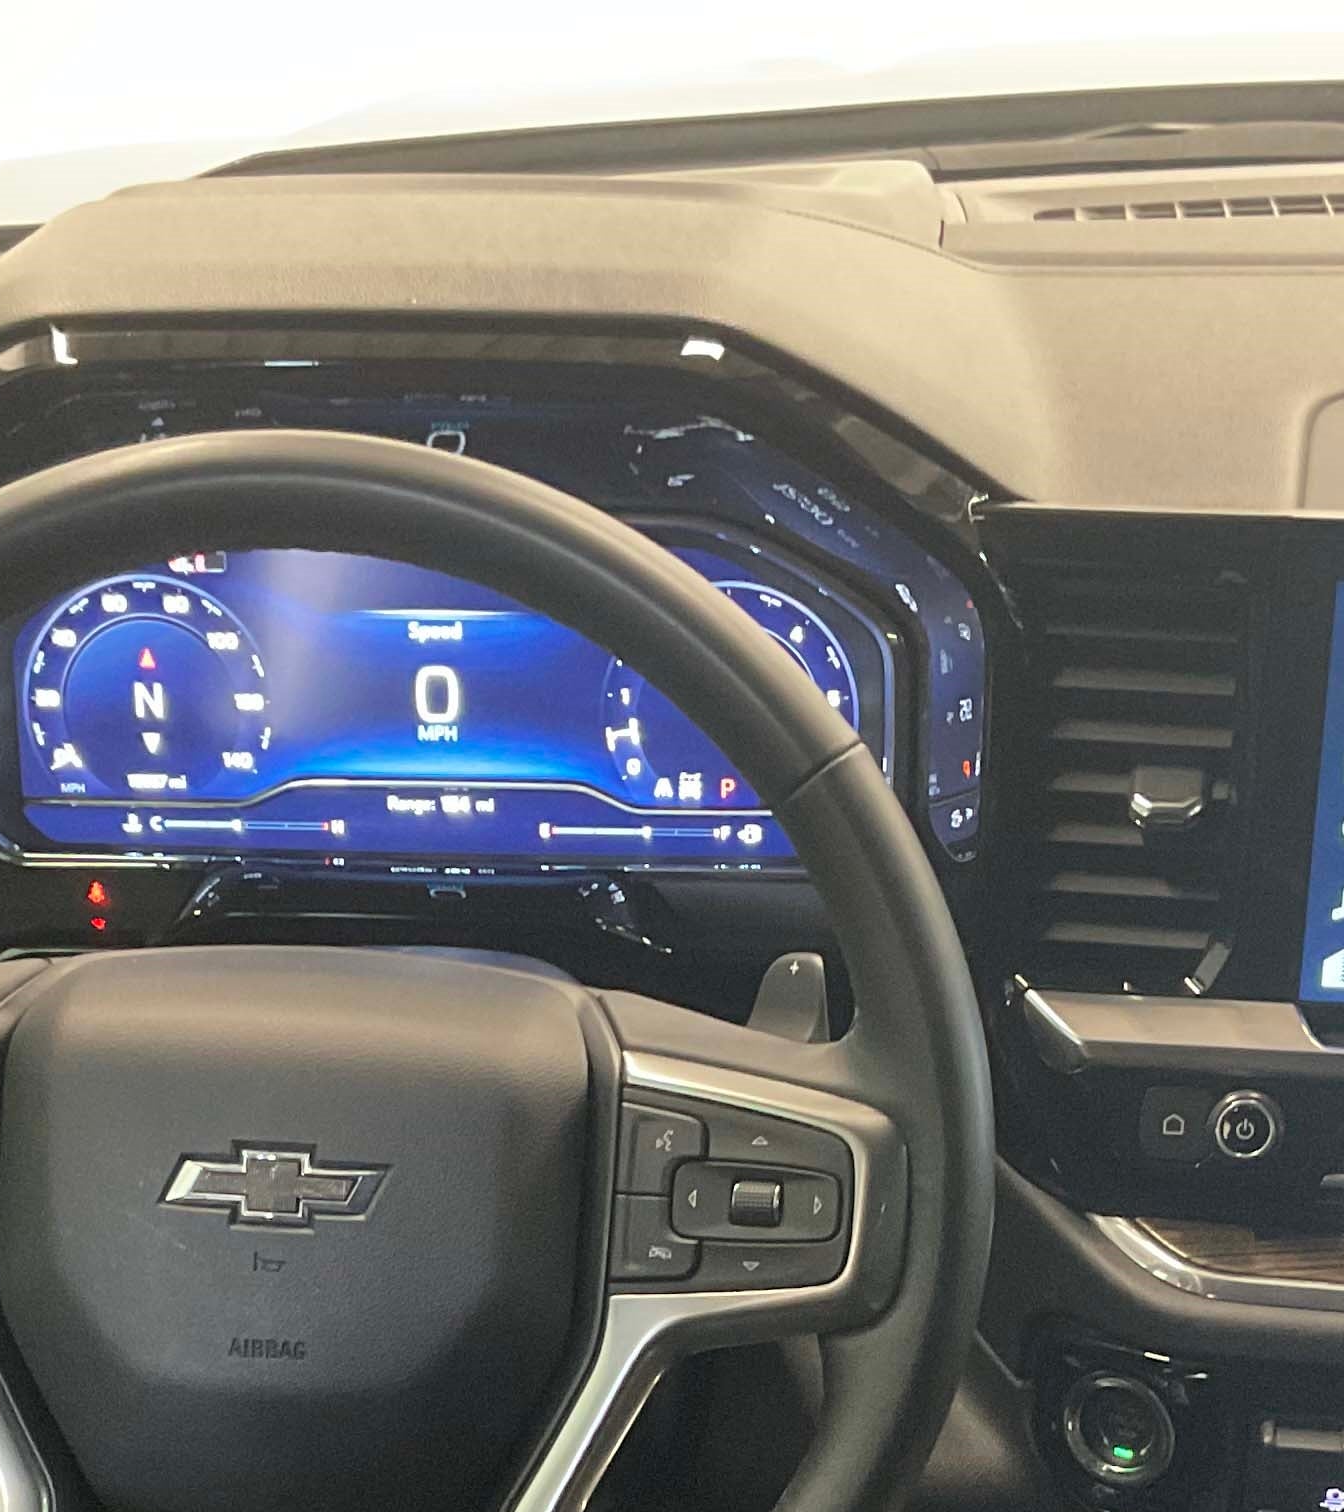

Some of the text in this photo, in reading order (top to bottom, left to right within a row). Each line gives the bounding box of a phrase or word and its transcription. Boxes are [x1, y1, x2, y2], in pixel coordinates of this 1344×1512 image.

[408, 621, 463, 643] Speed
[133, 680, 165, 719] N
[415, 665, 459, 724] 0
[417, 724, 459, 742] MPH
[60, 782, 86, 793] MPH
[720, 778, 736, 799] P
[386, 795, 436, 815] Range:
[475, 798, 495, 813] mi
[227, 1337, 306, 1361] AIRBAG
